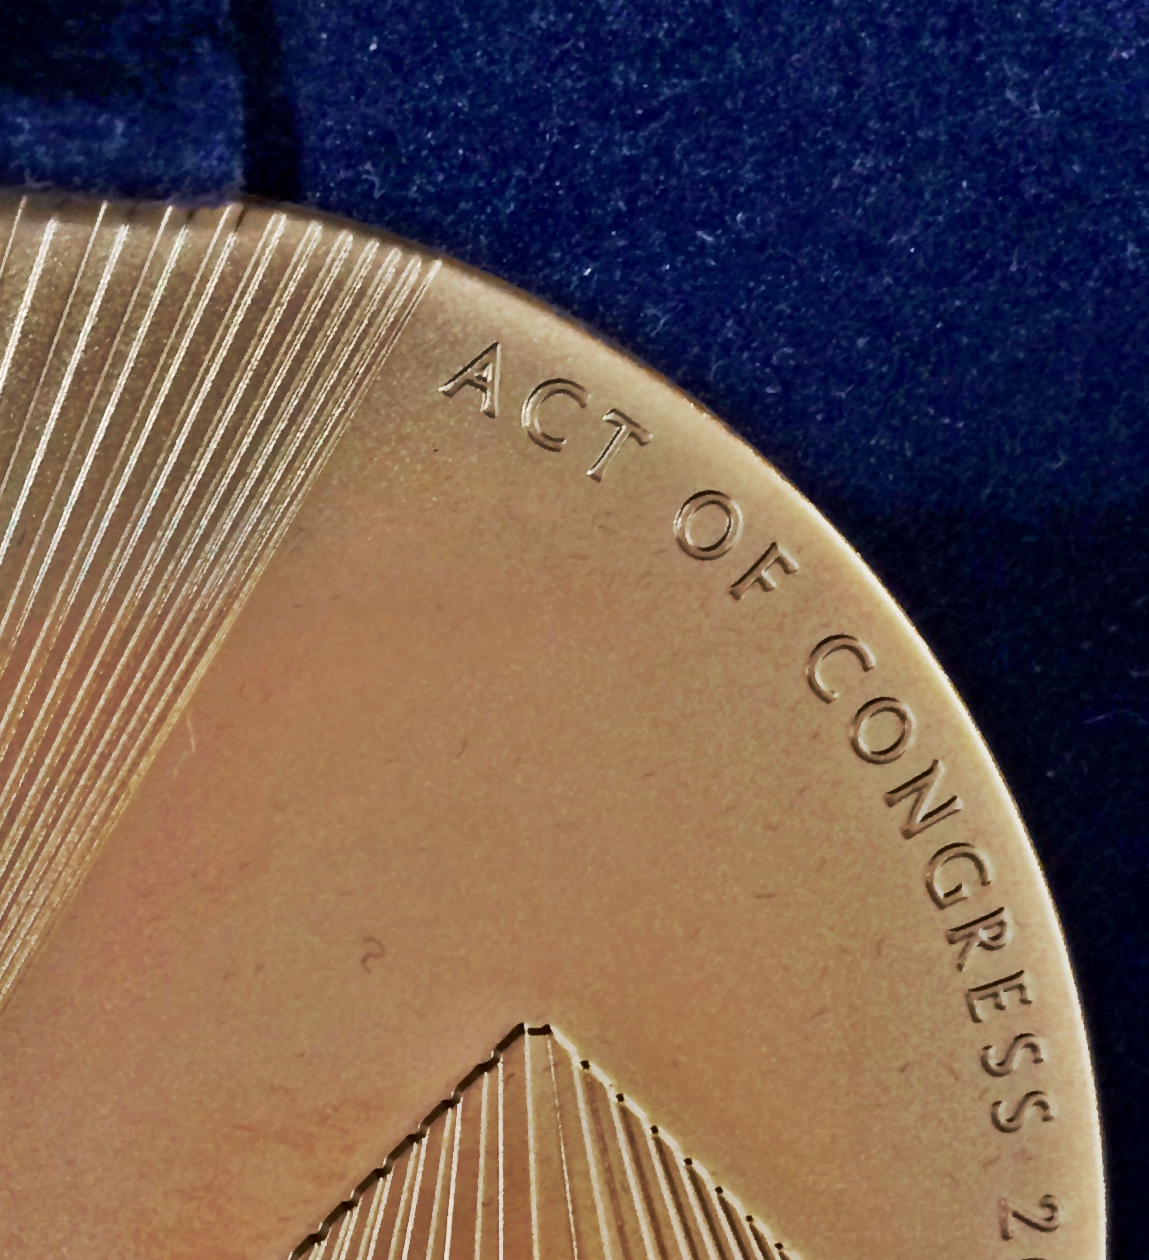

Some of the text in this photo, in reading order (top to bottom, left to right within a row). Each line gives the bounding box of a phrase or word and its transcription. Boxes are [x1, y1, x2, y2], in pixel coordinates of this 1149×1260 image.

[438, 341, 653, 482] ACT
[673, 489, 800, 600] OF
[806, 634, 1055, 1134] CONGRESS
